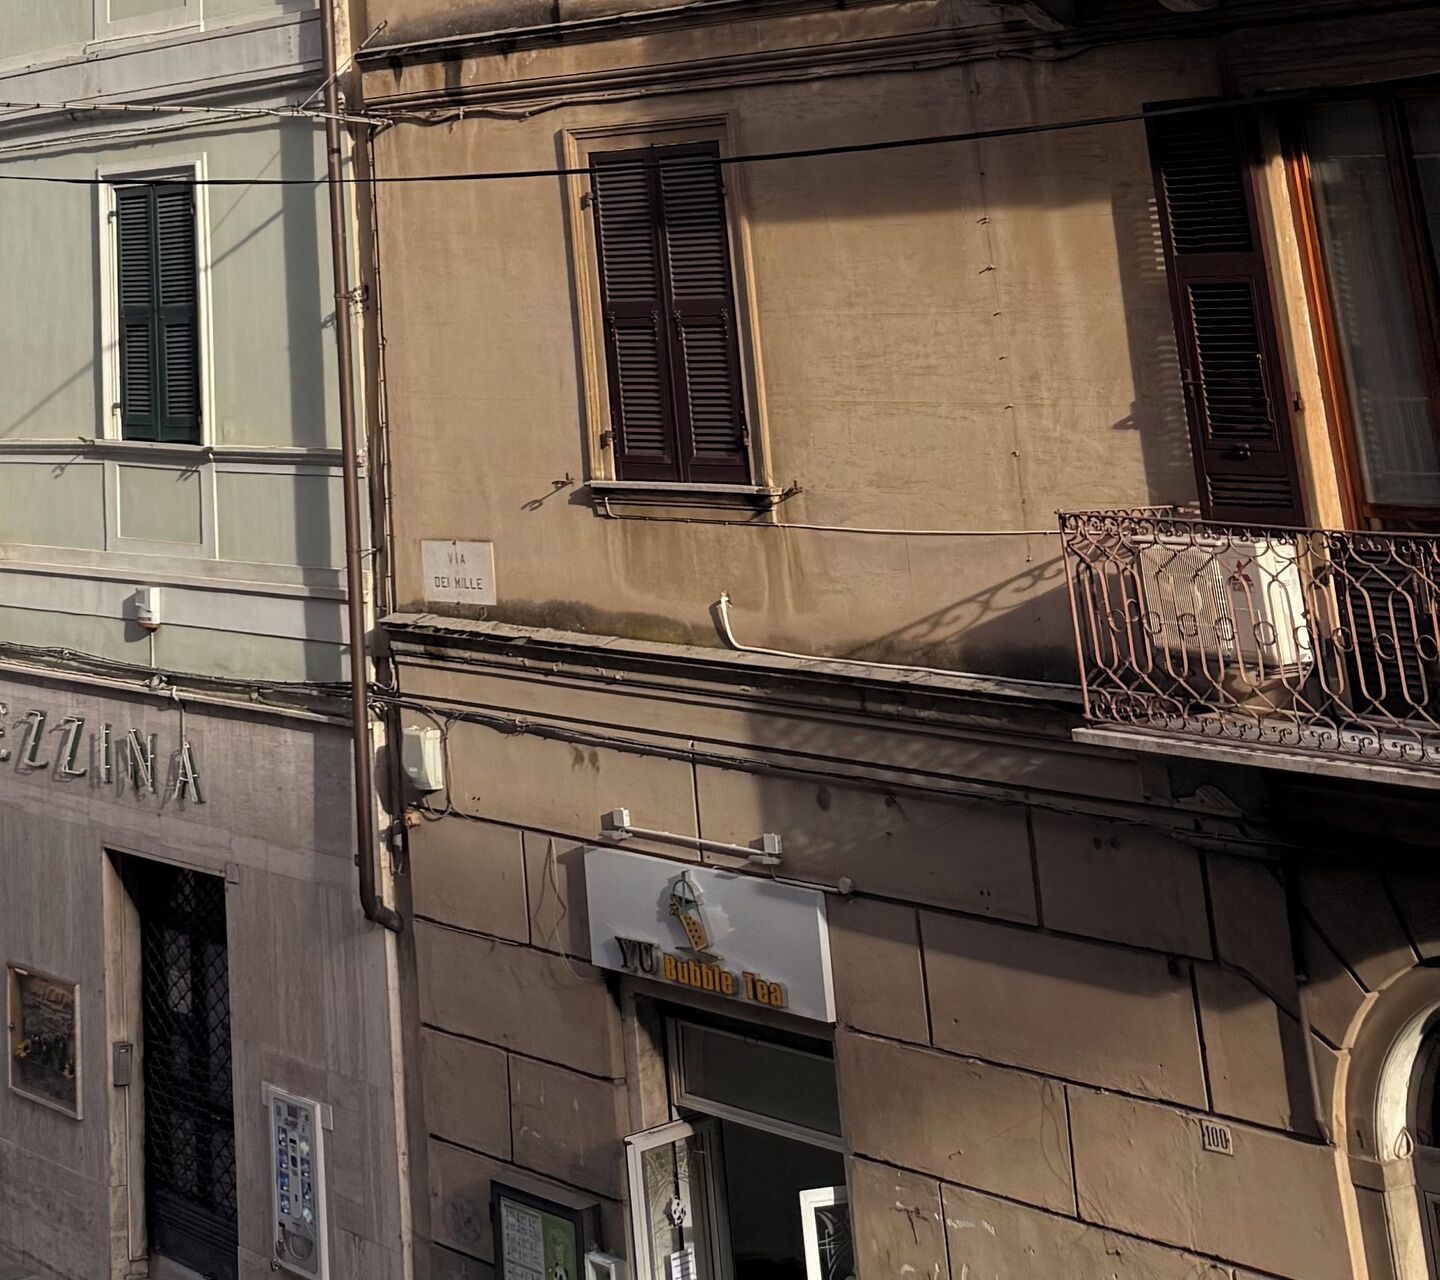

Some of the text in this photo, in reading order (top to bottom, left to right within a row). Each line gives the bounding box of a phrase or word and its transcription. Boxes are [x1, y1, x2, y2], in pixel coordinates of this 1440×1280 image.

[448, 552, 466, 565] VIA
[434, 576, 483, 590] DEI MILLE
[614, 936, 784, 1007] YU Bubble Tea
[1205, 1125, 1228, 1150] 100
